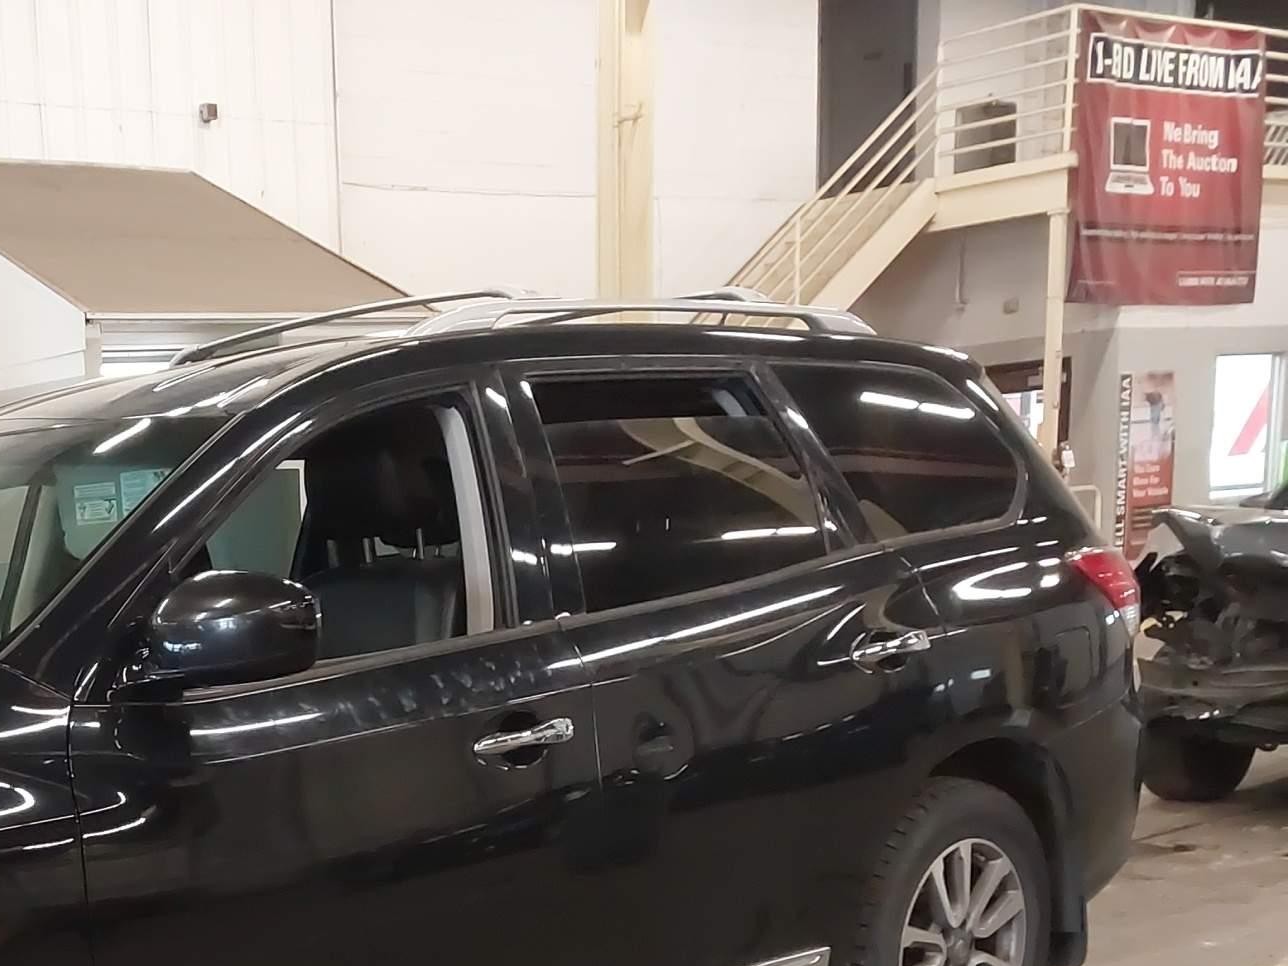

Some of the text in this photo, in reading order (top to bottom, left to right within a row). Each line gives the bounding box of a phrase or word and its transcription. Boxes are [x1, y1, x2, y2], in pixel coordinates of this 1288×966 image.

[1139, 48, 1176, 83] LIVE
[1183, 123, 1219, 149] Bring
[1161, 148, 1184, 169] The
[1160, 176, 1200, 198] To You
[1120, 378, 1131, 406] IAA
[1119, 410, 1129, 455] WITH
[1116, 459, 1128, 516] SMART
